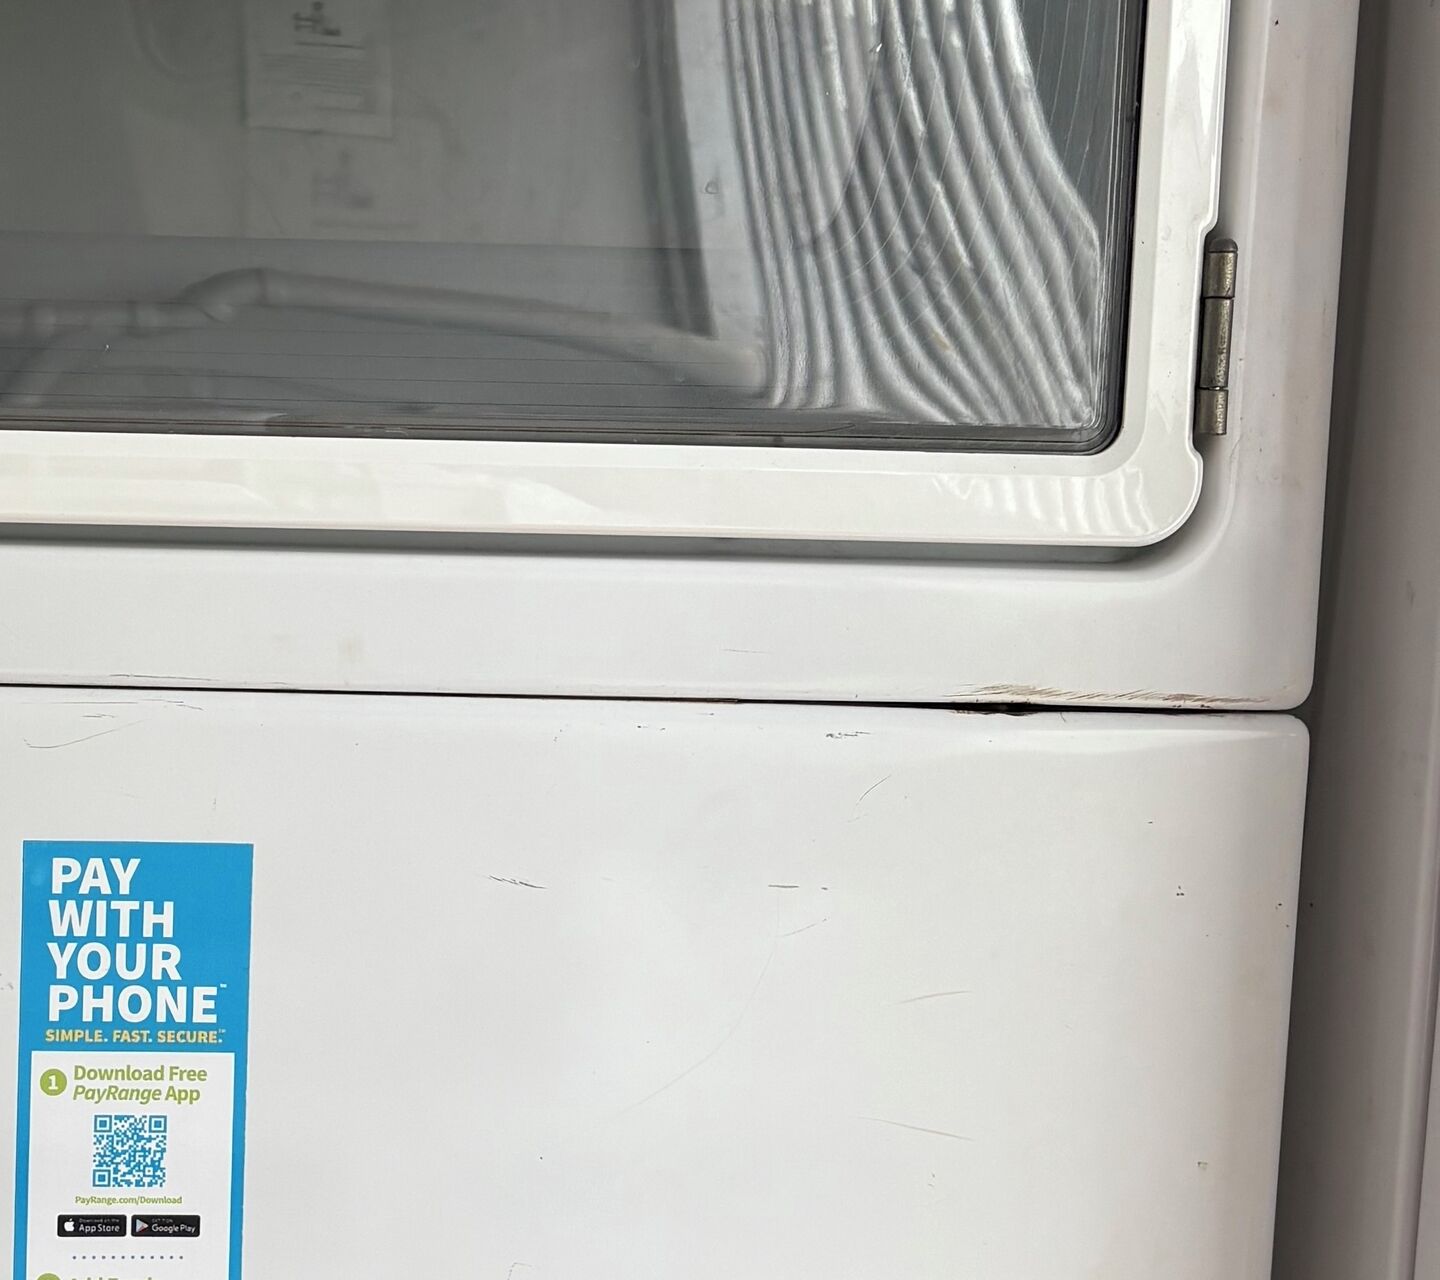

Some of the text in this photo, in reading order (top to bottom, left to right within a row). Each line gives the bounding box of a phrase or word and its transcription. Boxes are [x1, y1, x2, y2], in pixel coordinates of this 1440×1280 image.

[52, 858, 141, 895] PAY
[48, 900, 174, 938] WITH
[46, 942, 182, 980] YOUR
[49, 985, 218, 1023] PHONE
[46, 1029, 222, 1043] SIMPLE. FAST. SECURE.
[73, 1065, 165, 1081] Download
[169, 1066, 207, 1082] Free
[73, 1085, 200, 1104] PayRange App
[75, 1196, 182, 1205] PayRange.com/Download
[79, 1224, 120, 1233] App Store
[152, 1224, 196, 1233] Google Play
